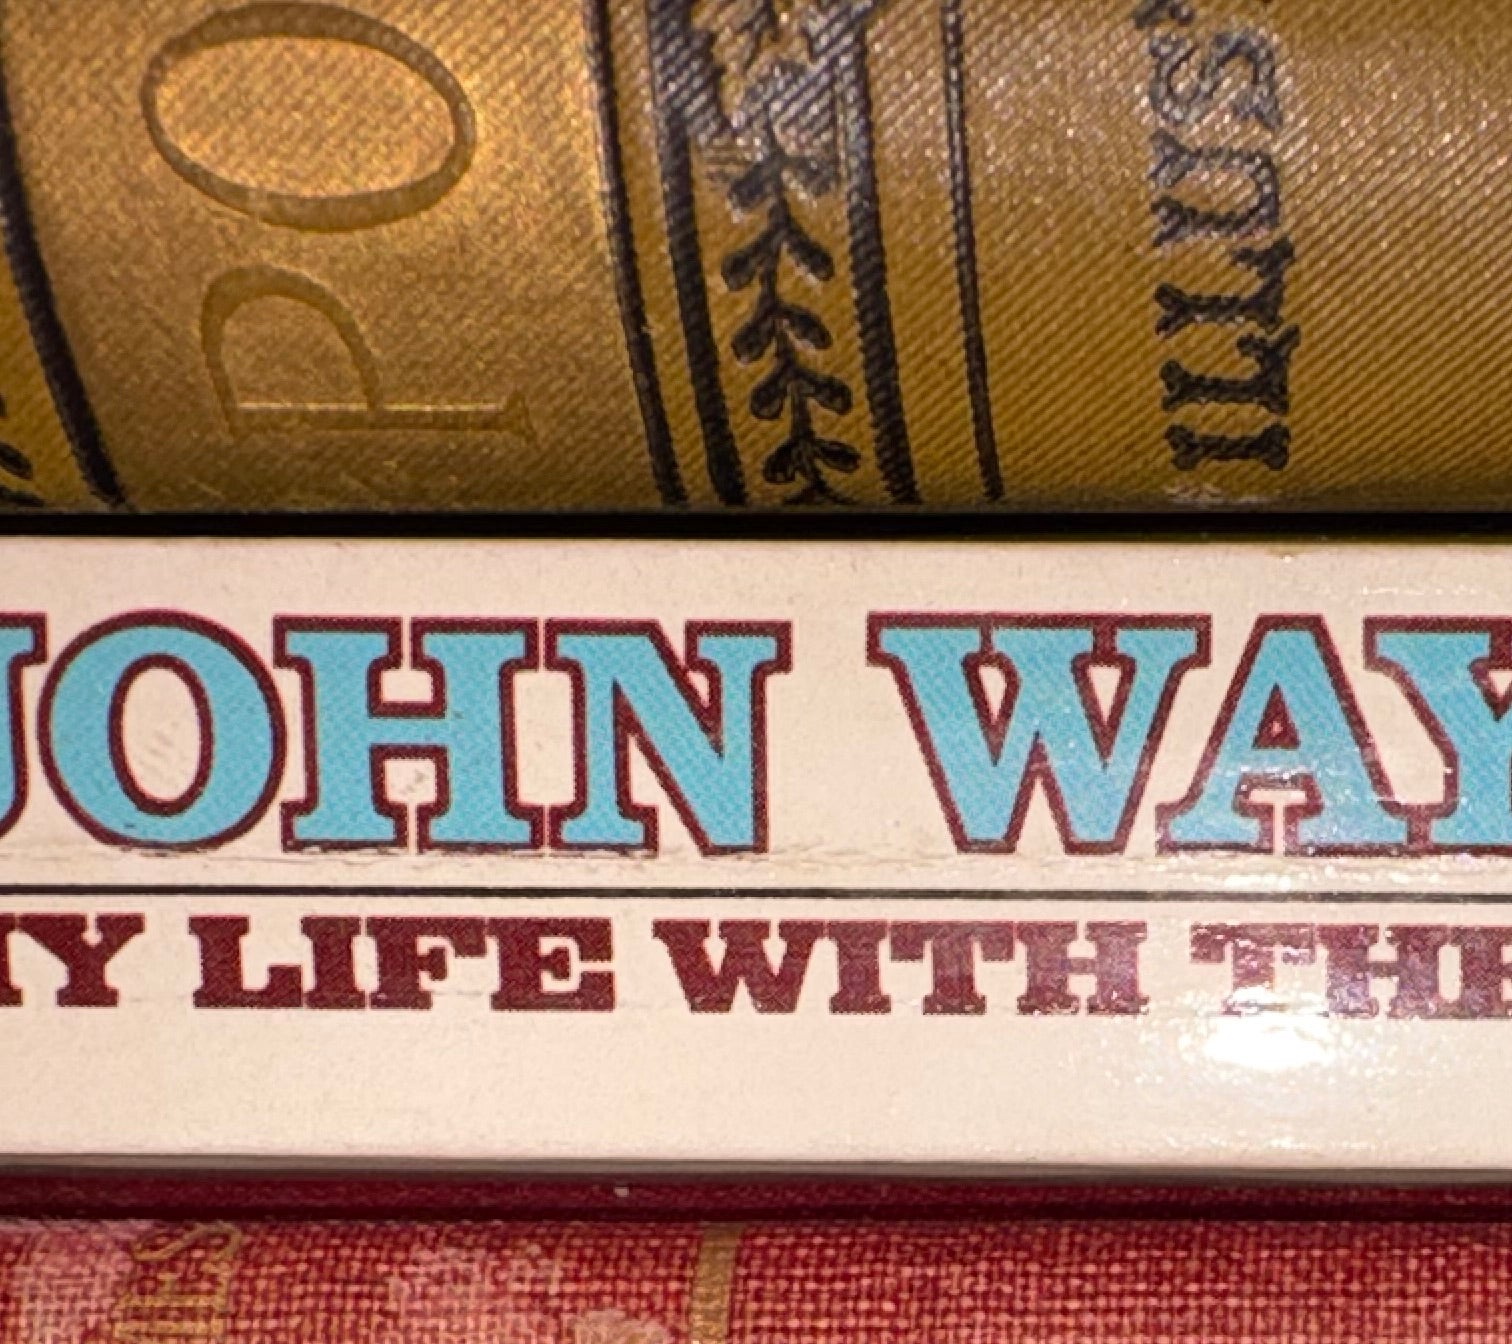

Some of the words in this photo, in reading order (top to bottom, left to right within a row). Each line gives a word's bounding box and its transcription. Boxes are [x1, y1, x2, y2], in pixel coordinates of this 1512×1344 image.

[0, 912, 145, 1009] Y
[188, 914, 616, 1013] LIFE
[652, 919, 1149, 1016] WITH
